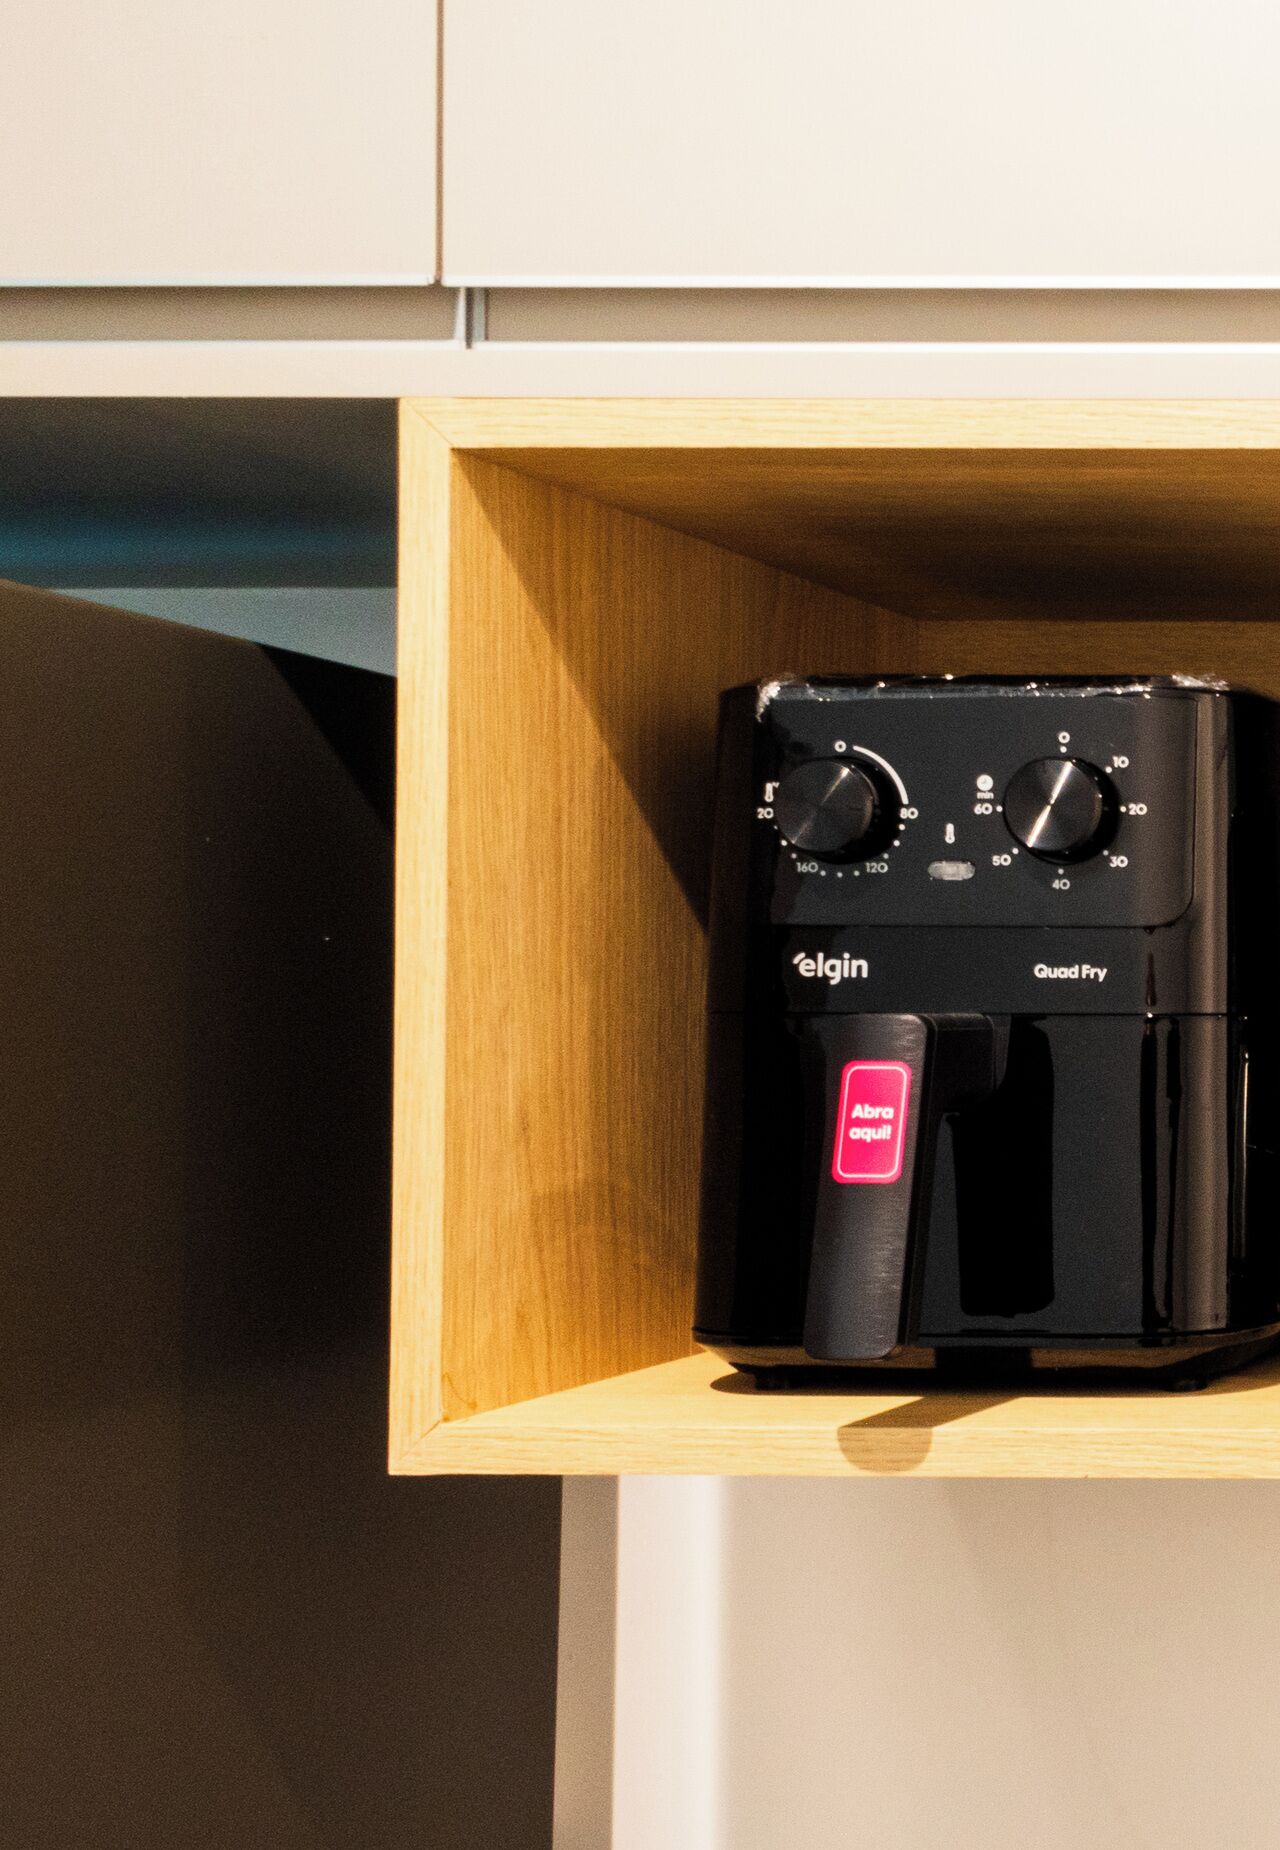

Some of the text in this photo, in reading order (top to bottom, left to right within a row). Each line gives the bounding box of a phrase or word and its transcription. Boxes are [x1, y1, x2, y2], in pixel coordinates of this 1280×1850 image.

[1112, 756, 1129, 768] 10
[976, 792, 994, 800] min
[757, 808, 774, 819] 20
[900, 807, 919, 819] 80
[974, 803, 993, 815] 60
[1128, 803, 1148, 815] 20
[992, 854, 1012, 866] 50
[1109, 855, 1129, 868] 30
[796, 862, 818, 873] 160
[866, 862, 888, 873] 120
[1052, 879, 1070, 890] 40
[793, 952, 868, 985] elgin
[1034, 963, 1108, 982] Quad Fry
[851, 1103, 894, 1119] Abra
[849, 1125, 892, 1143] aqui!
